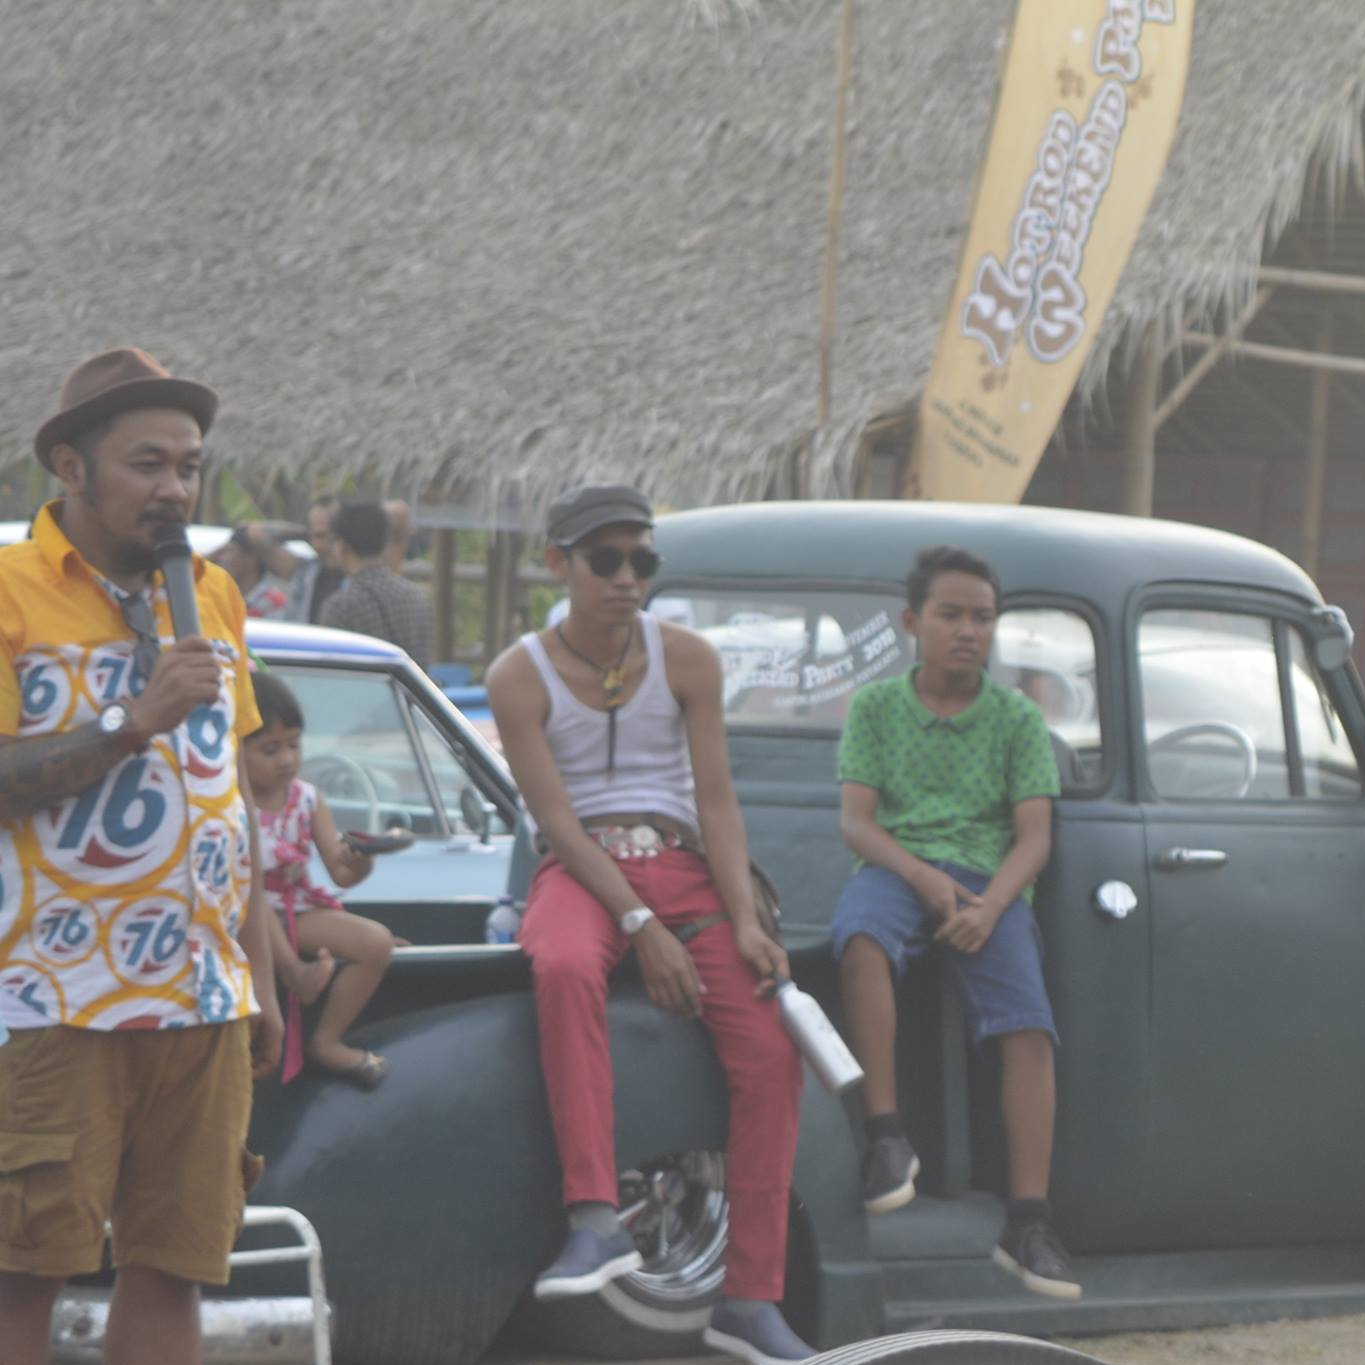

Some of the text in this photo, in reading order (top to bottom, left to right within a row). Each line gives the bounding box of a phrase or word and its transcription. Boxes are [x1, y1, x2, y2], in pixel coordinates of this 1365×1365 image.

[963, 110, 1078, 367] HOTROD
[1026, 79, 1128, 362] WEEKEND
[41, 909, 89, 946] 76
[125, 913, 187, 966] 76
